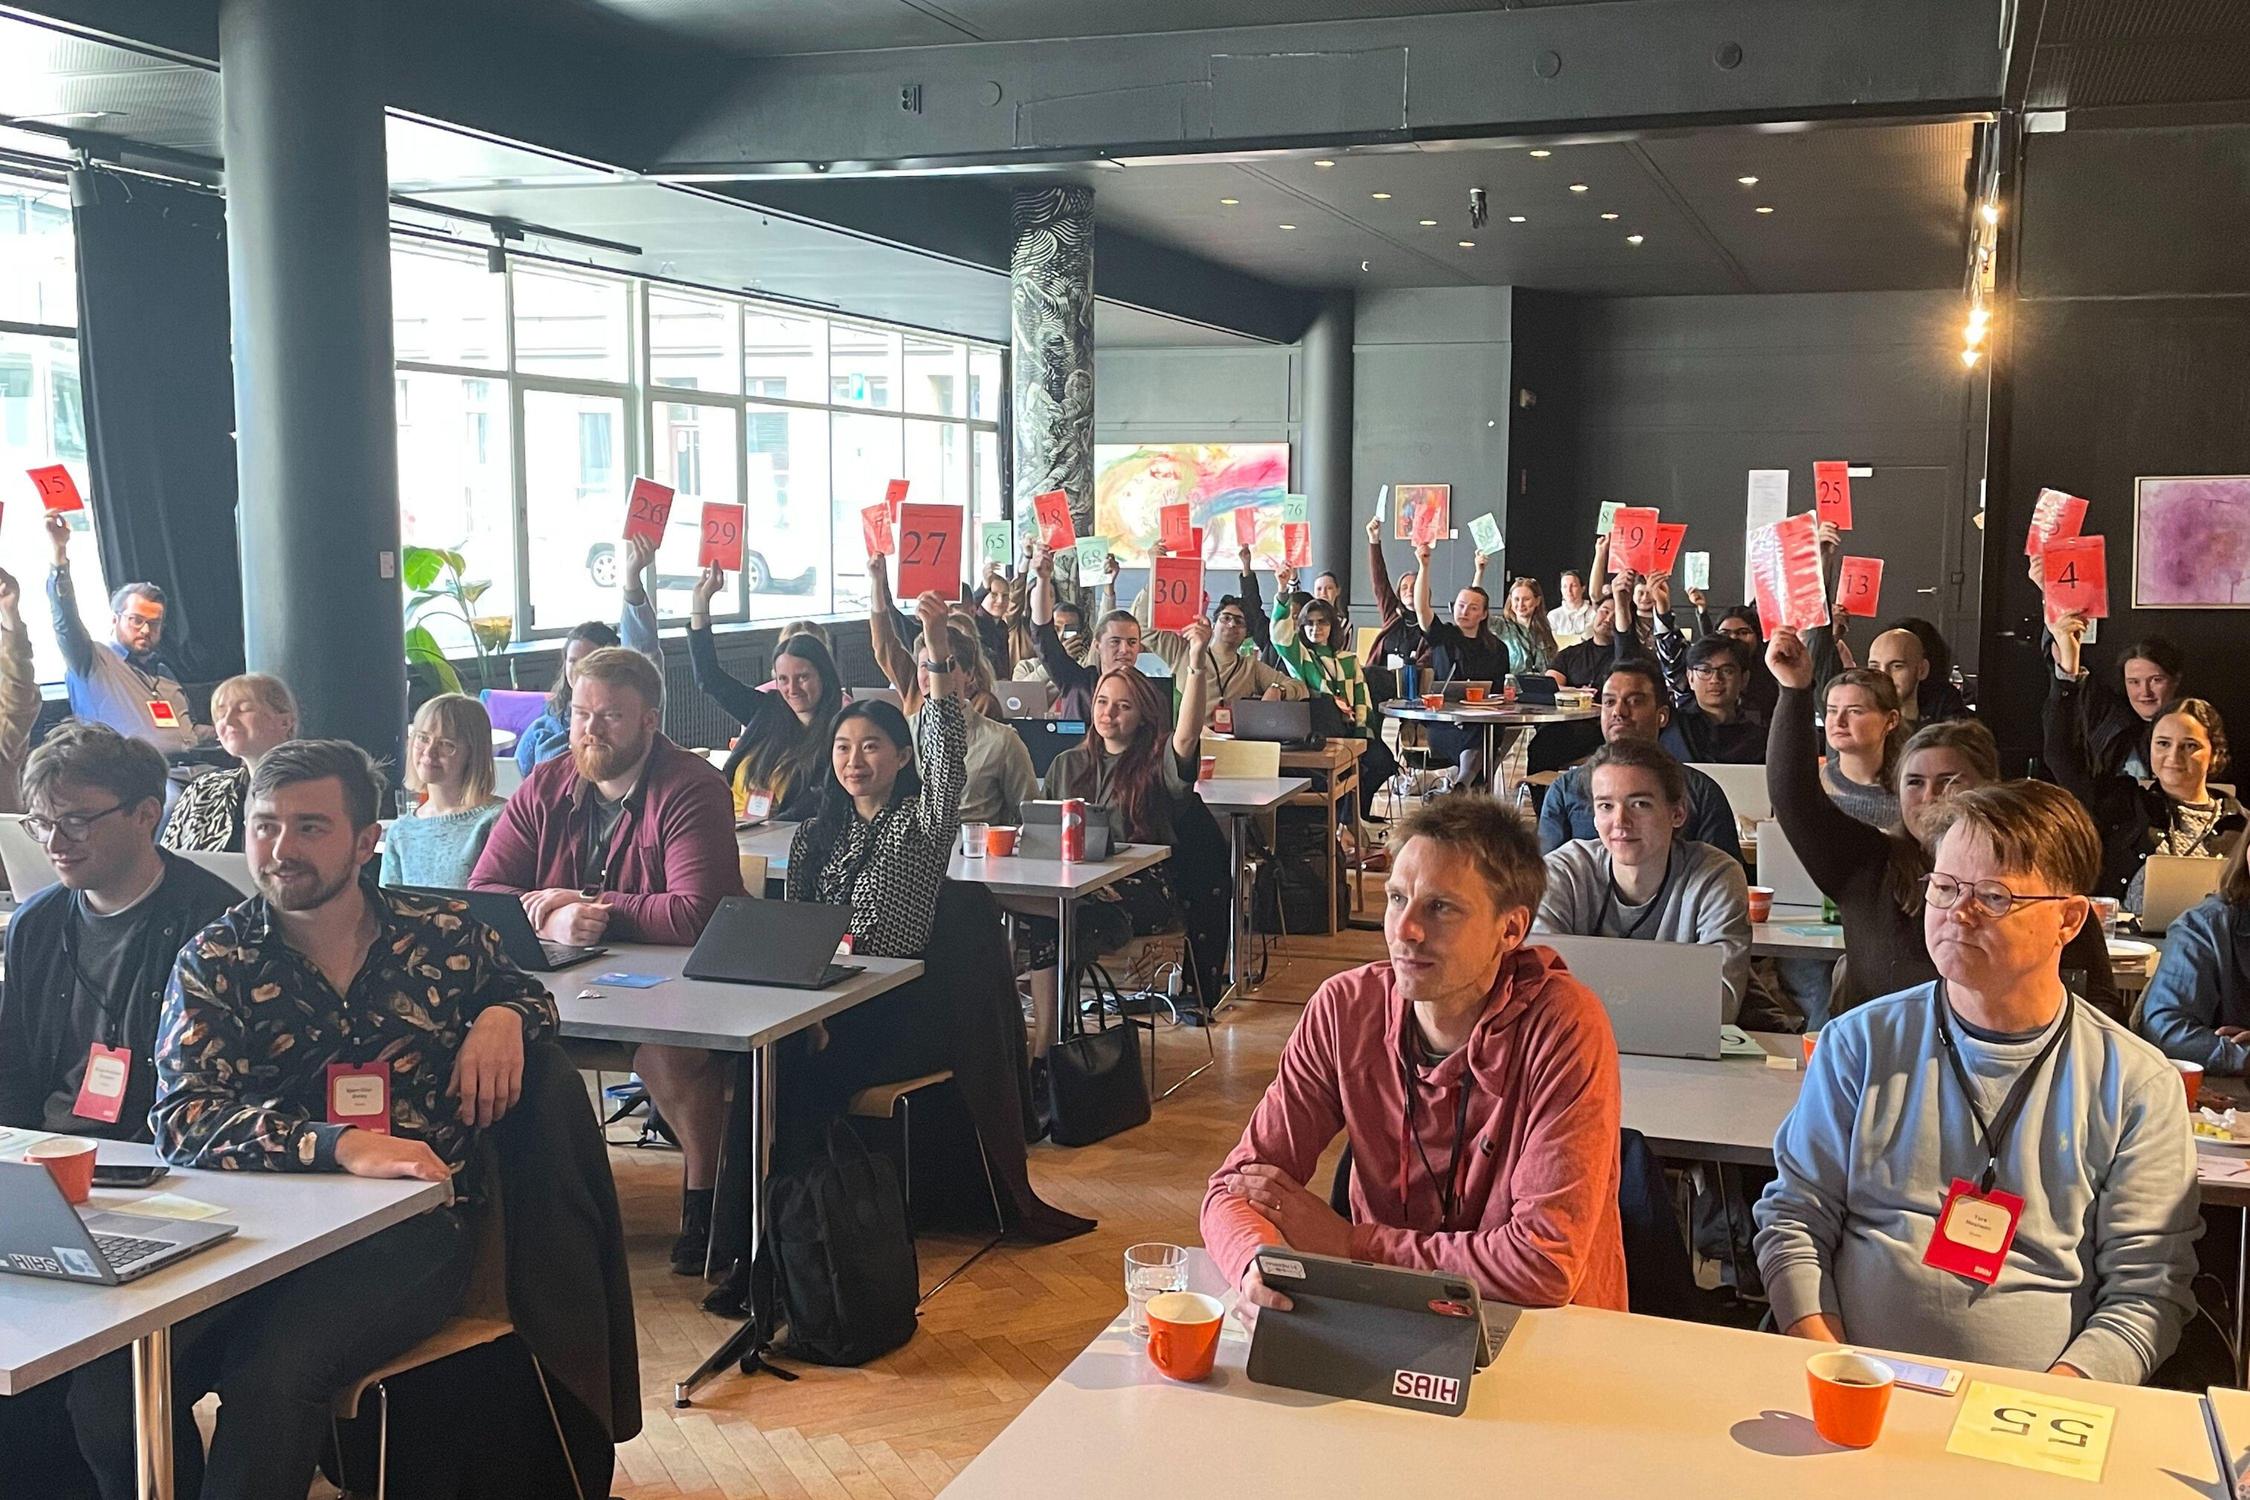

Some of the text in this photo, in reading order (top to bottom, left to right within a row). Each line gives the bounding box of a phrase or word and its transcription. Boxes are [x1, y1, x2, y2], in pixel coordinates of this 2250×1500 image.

[38, 475, 66, 495] 15
[1820, 481, 1842, 504] 25
[632, 496, 664, 525] 26
[1041, 508, 1064, 529] 18
[1287, 503, 1303, 516] 76
[705, 520, 736, 546] 29
[985, 533, 1005, 549] 65
[902, 530, 947, 566] 27
[1846, 574, 1869, 595] 13
[2058, 561, 2079, 589] 4
[1155, 578, 1187, 605] 30
[1395, 1372, 1458, 1403] SAIH
[1990, 1407, 2094, 1448] 55
